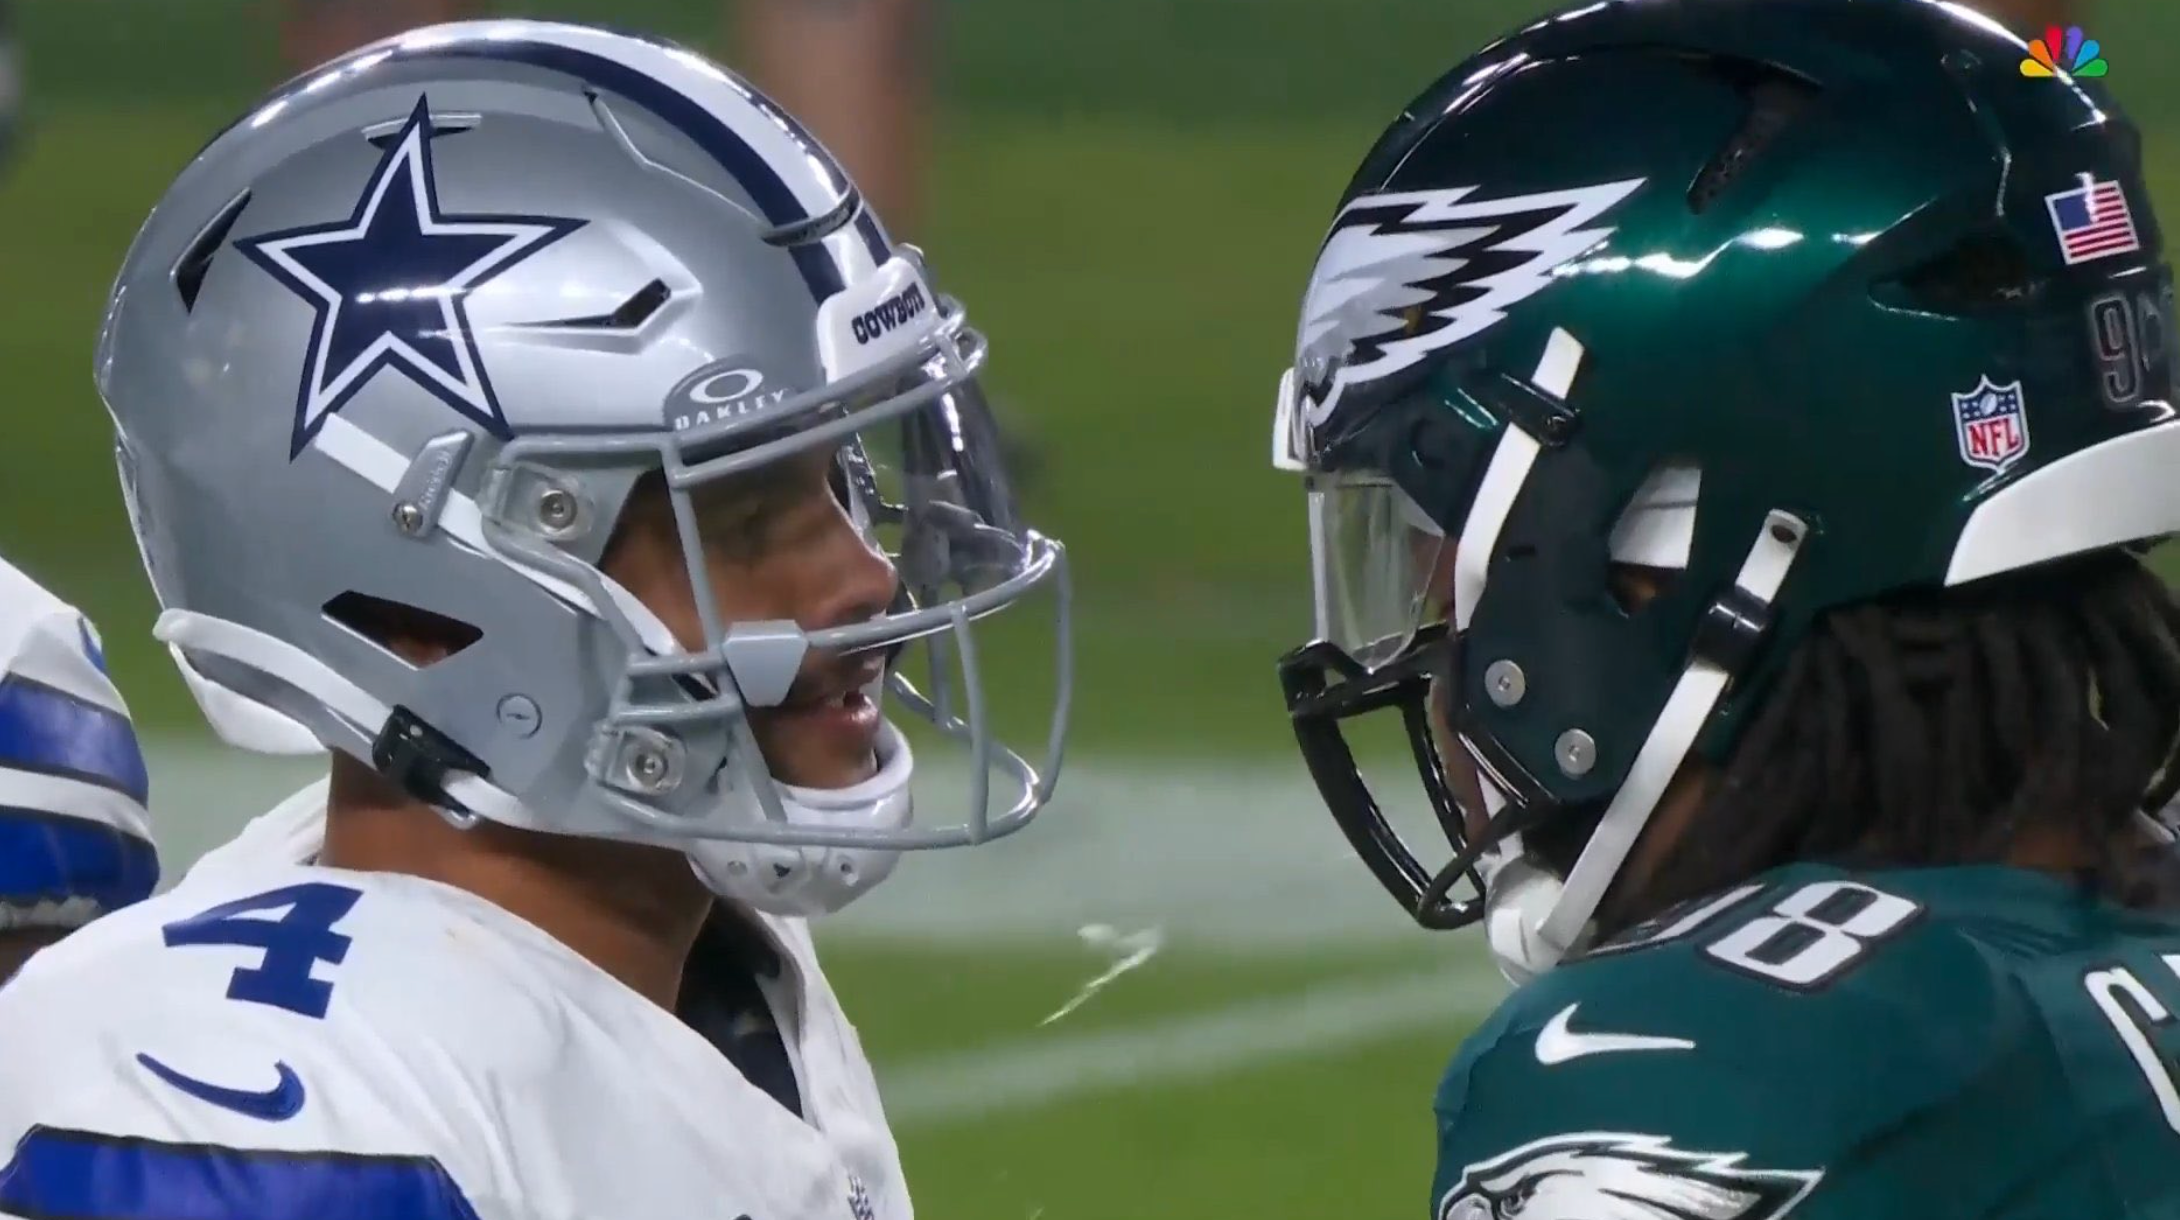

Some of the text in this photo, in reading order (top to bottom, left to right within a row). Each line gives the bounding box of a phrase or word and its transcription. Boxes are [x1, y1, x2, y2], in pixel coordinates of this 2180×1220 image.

[674, 387, 788, 430] OAKLEY
[1967, 417, 2019, 456] NFL
[162, 881, 365, 1020] 4
